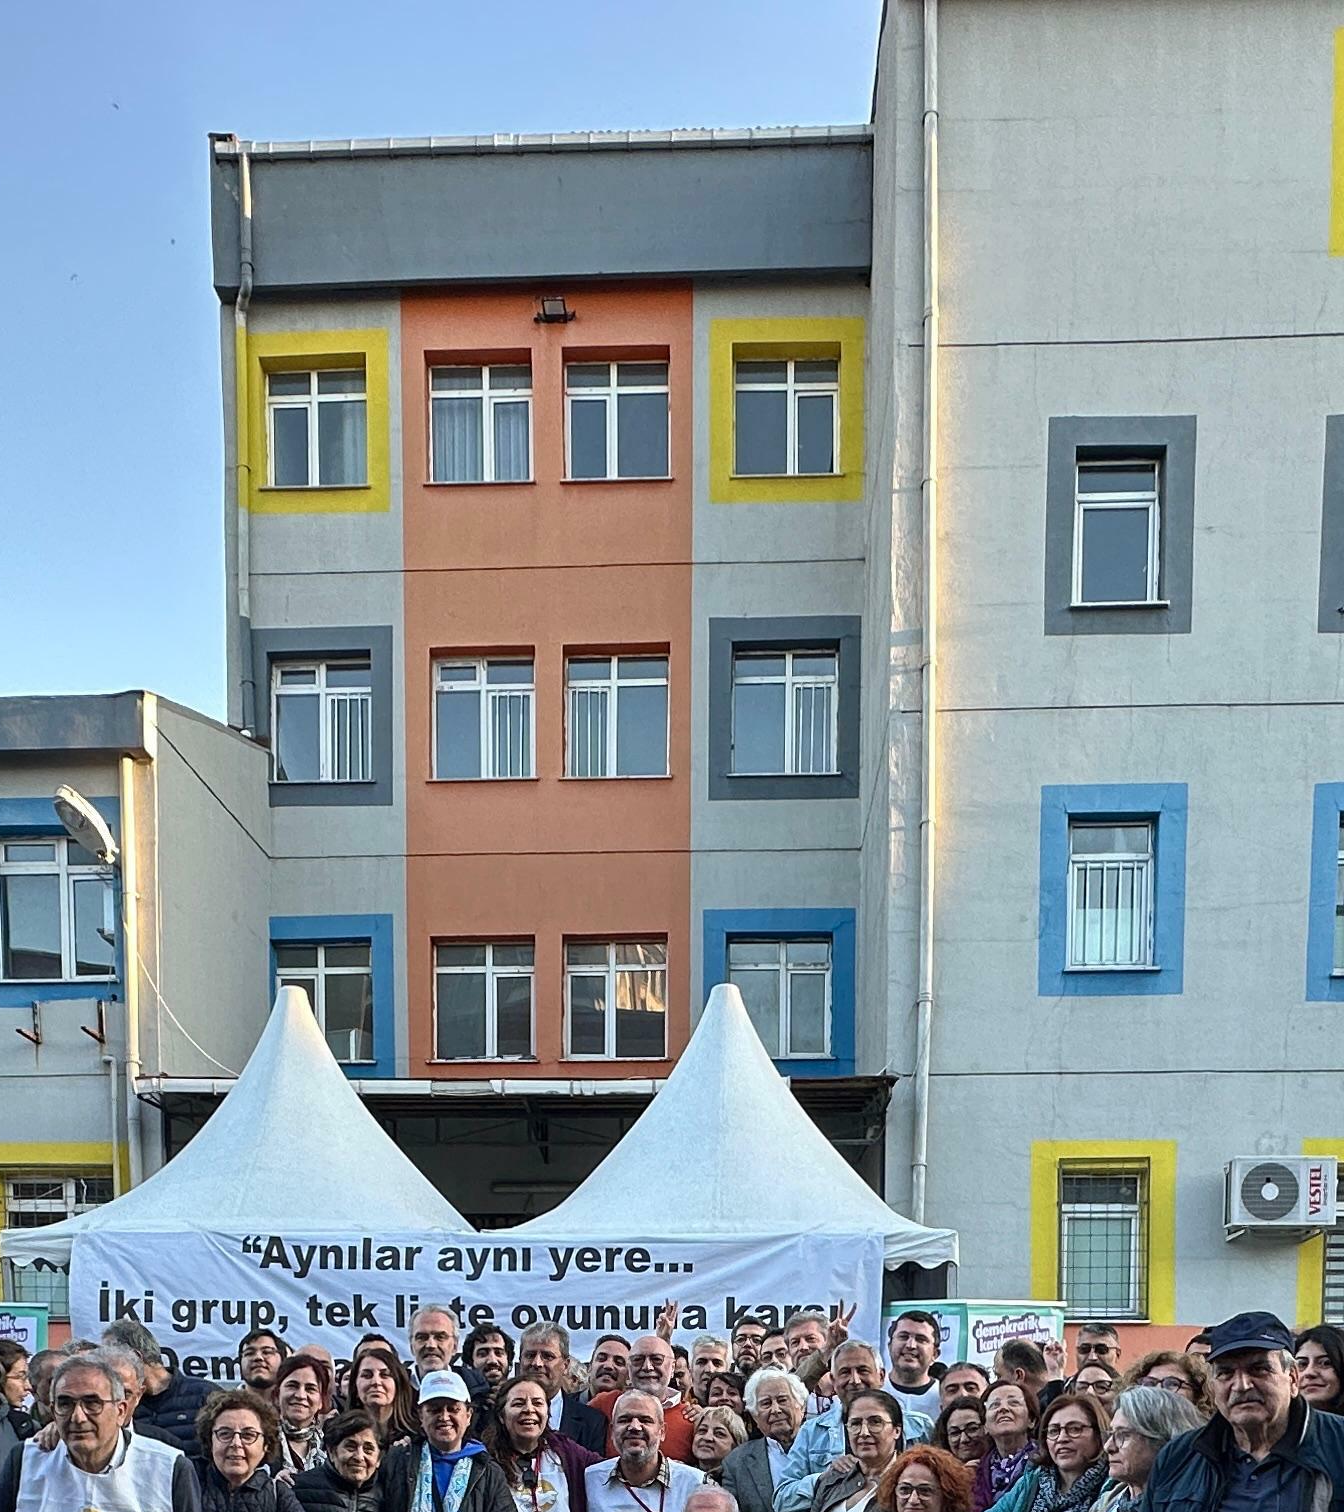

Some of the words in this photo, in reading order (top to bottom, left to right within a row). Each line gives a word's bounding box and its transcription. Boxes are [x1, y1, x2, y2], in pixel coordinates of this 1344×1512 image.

[1308, 1164, 1323, 1216] VESTEL
[241, 1235, 423, 1279] “Aynılar
[437, 1246, 531, 1281] aynı
[548, 1246, 693, 1281] yere...
[99, 1281, 154, 1322] İki
[171, 1298, 289, 1334] grup,
[306, 1294, 380, 1328] tek
[395, 1294, 495, 1329] lite
[725, 1297, 840, 1330] karı
